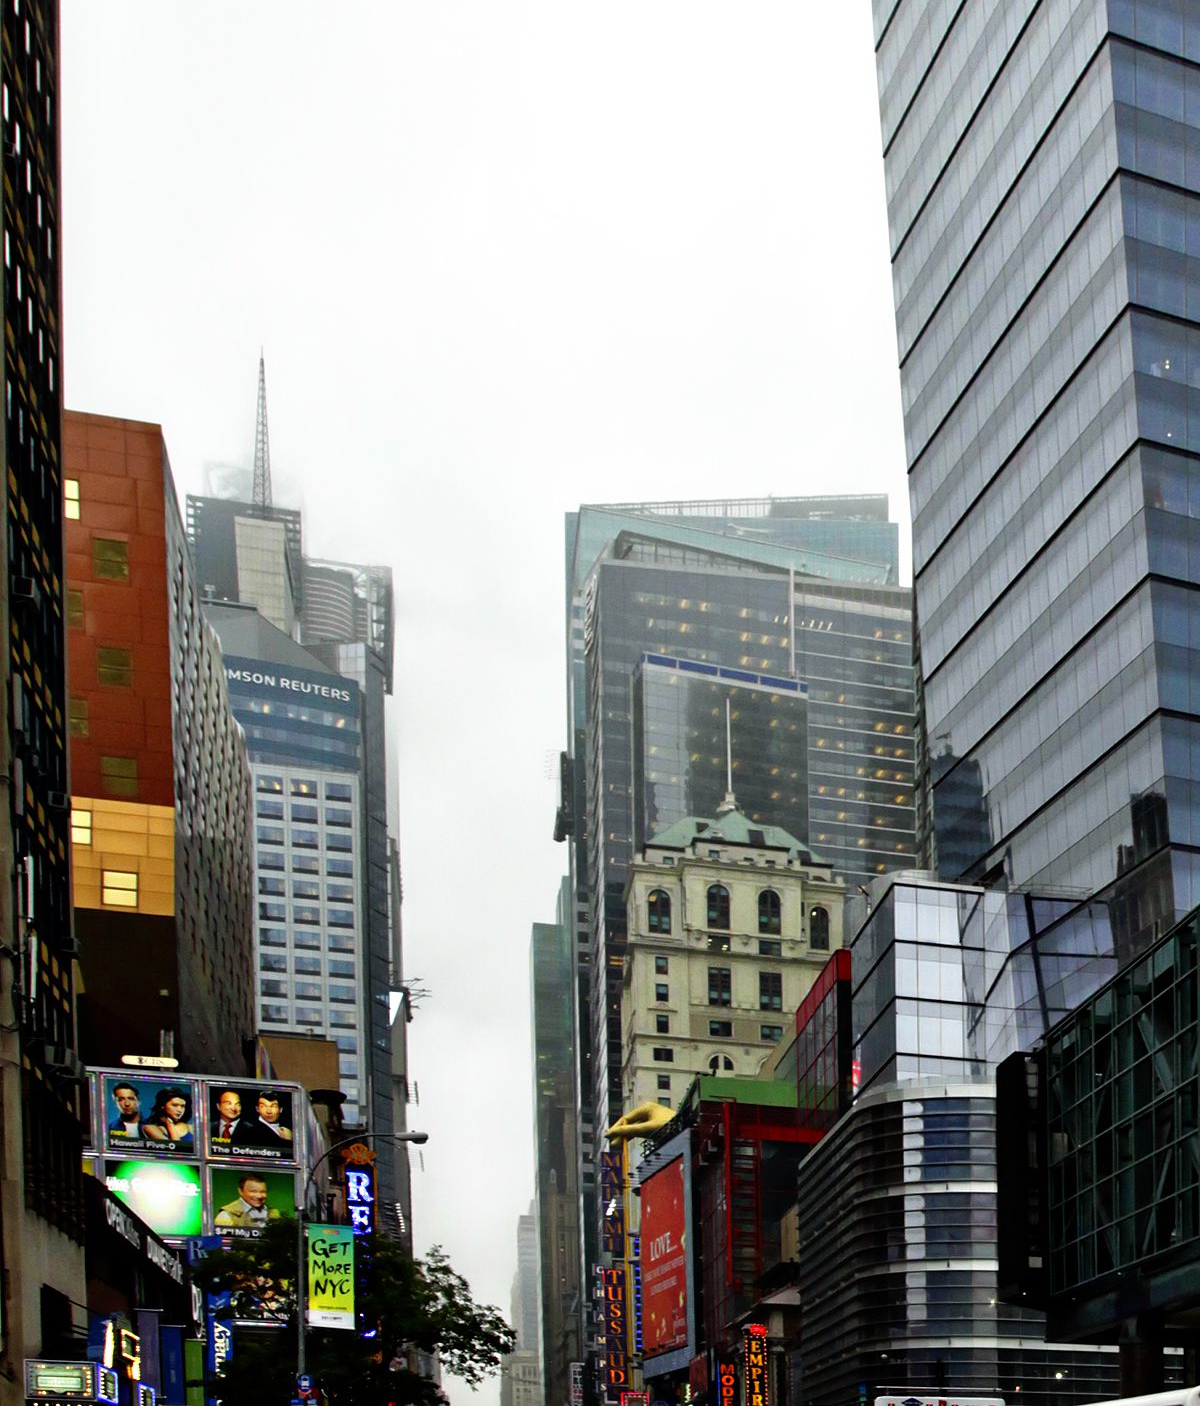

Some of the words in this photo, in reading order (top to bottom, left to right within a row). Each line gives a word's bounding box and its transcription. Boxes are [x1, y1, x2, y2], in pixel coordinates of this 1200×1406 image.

[279, 677, 351, 702] REUTERS
[212, 1145, 231, 1154] The
[232, 1147, 281, 1157] Defenders
[311, 1238, 350, 1258] GET
[312, 1259, 351, 1276] MORE
[314, 1278, 350, 1298] NYC
[596, 1266, 606, 1391] CHAMPS
